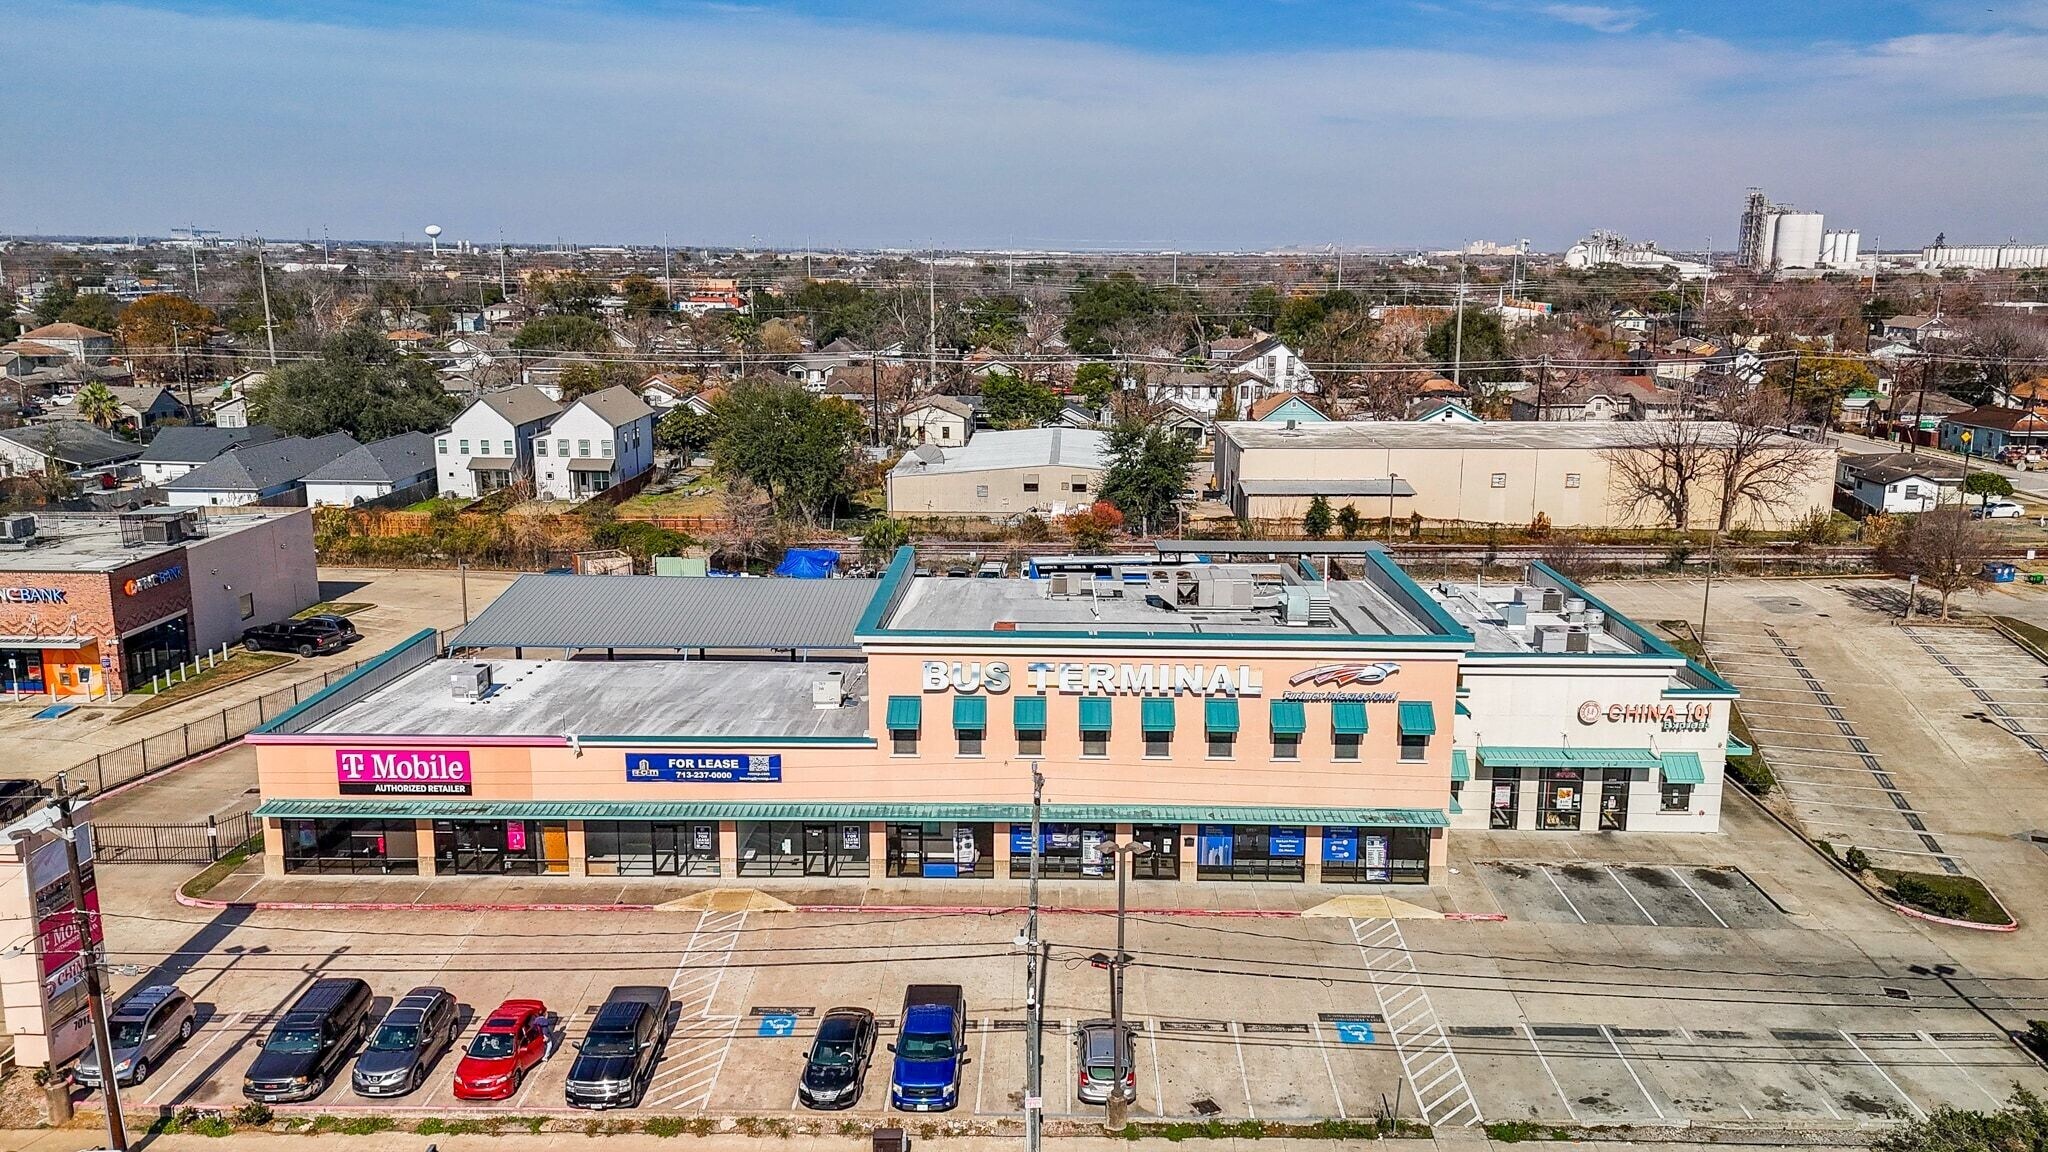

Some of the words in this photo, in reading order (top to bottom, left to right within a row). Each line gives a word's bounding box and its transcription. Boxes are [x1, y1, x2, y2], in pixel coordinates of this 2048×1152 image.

[136, 574, 159, 591] PNC
[159, 565, 184, 584] BANK
[0, 588, 21, 601] NC
[20, 588, 64, 602] BANK
[922, 661, 1011, 694] BUS
[1028, 662, 1263, 696] TERMINAL
[1608, 703, 1678, 721] CHINA
[1687, 702, 1713, 722] 101
[1662, 721, 1710, 733] Express
[341, 753, 364, 779] T
[370, 753, 464, 780] Mobile
[668, 758, 695, 769] FOR
[698, 759, 739, 769] LEASE
[675, 770, 733, 780] 713-237-0000
[374, 784, 427, 793] AUTHORIZED
[427, 784, 466, 793] RETAILER
[57, 958, 86, 985] CHIN
